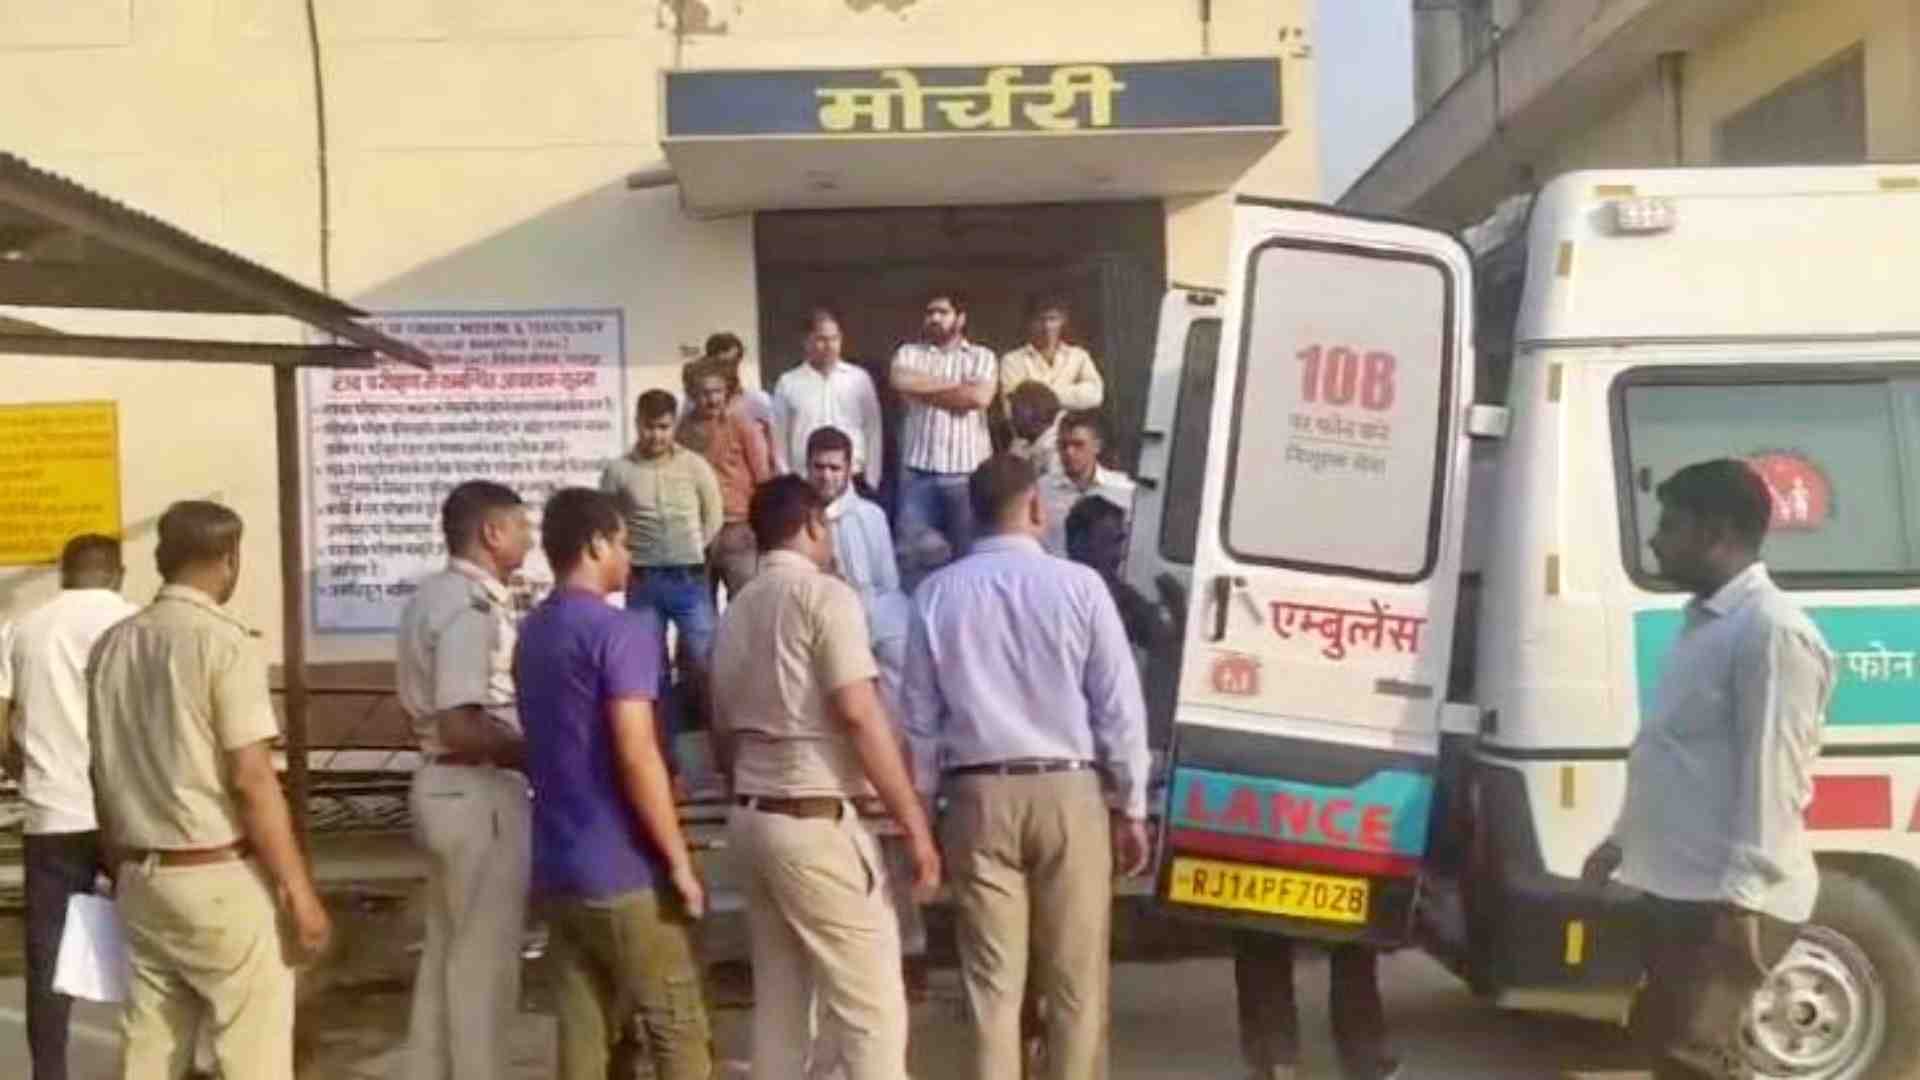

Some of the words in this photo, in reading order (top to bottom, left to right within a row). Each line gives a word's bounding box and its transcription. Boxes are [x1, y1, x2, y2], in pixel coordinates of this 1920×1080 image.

[815, 65, 1127, 130] मोर्चरी
[1296, 344, 1396, 411] 108
[1269, 598, 1428, 660] एम्बुलेंस
[1845, 640, 1917, 682] फोन
[1187, 779, 1393, 850] LANCE
